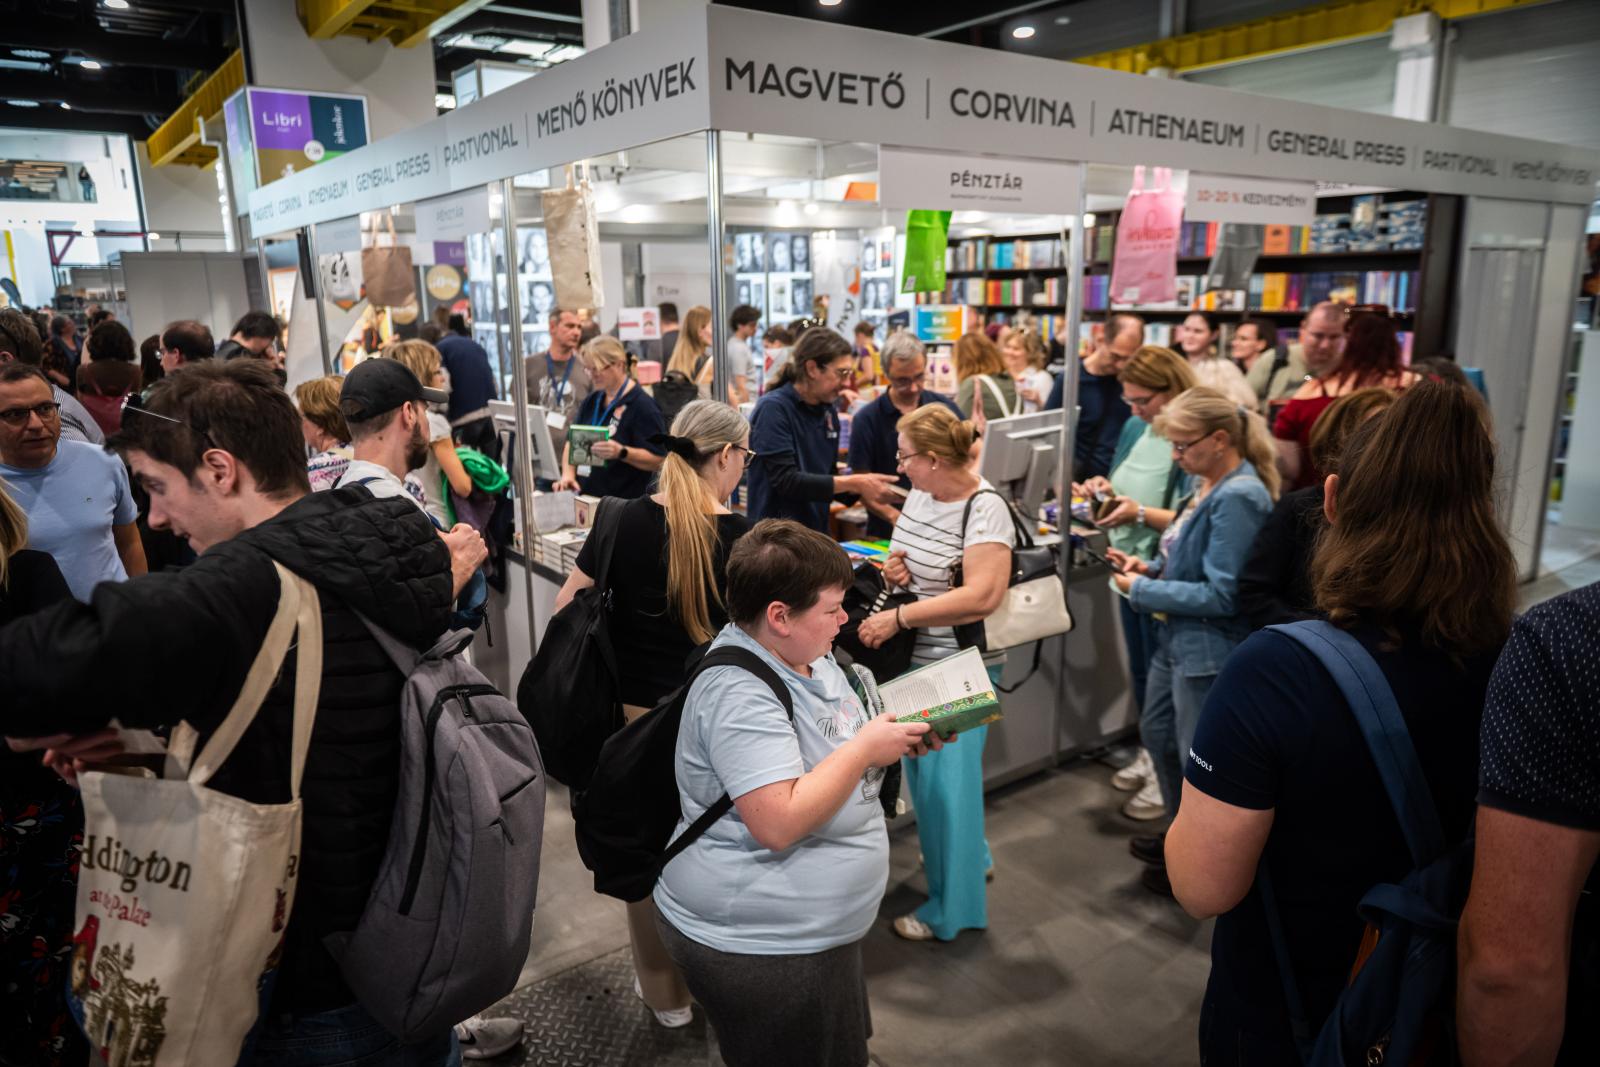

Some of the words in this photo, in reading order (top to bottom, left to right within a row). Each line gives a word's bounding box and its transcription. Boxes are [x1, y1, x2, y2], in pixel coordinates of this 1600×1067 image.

[262, 111, 303, 127] Libri
[308, 179, 349, 207] ATHENAEUM
[356, 158, 395, 192] GENERAL
[396, 152, 430, 181] PRESS
[444, 129, 518, 167] PARTVONAL
[536, 92, 587, 139] MENŐ
[592, 57, 696, 118] KÖNYVEK
[725, 57, 905, 109] MAGVETŐ
[950, 88, 1076, 128] CORVINA
[1109, 109, 1245, 148] ATHENAEUM
[1268, 130, 1348, 160] GENERAL
[1354, 140, 1406, 168] PRESS
[1423, 149, 1498, 177] PARTVONAL
[950, 170, 1023, 190] PÉNZTÁR
